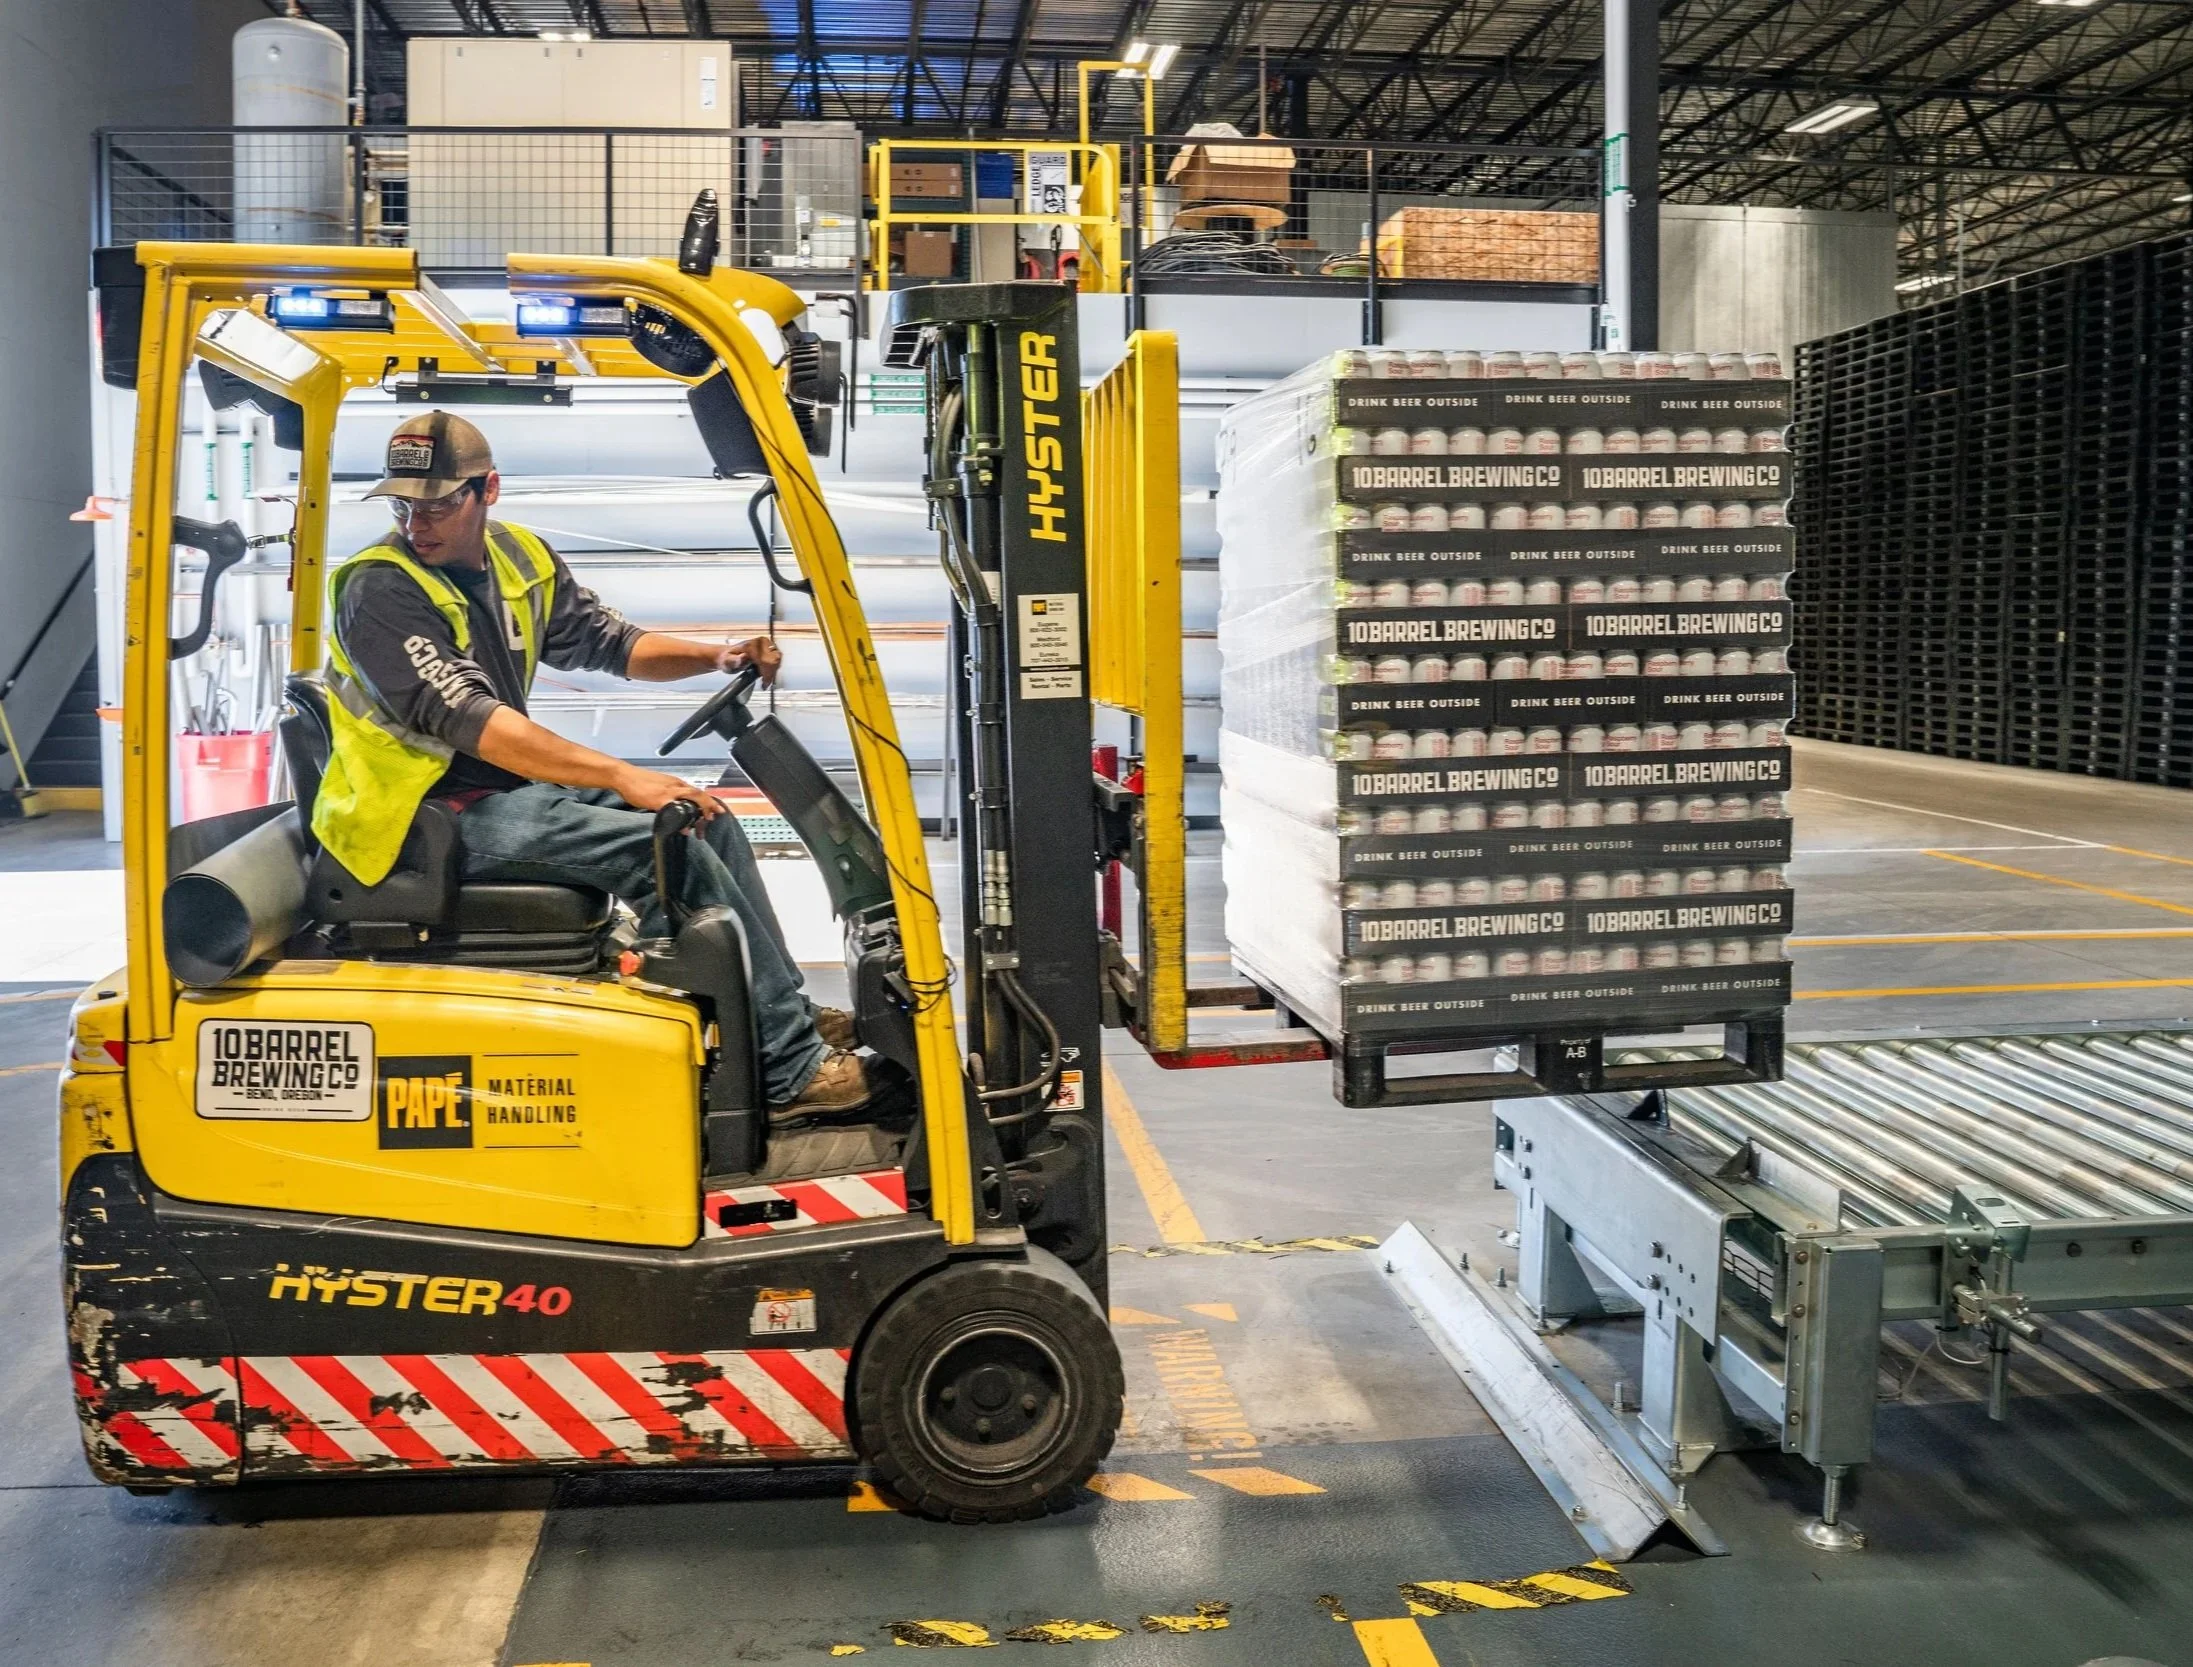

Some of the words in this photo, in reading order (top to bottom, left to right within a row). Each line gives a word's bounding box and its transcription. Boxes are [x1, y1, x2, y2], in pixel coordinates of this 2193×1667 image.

[1348, 398, 1388, 407] DRINK
[1392, 398, 1422, 407] BEER
[1426, 397, 1478, 407] OUTSIDE
[1505, 394, 1544, 404] DRINK
[1548, 394, 1577, 404] BEER
[1581, 394, 1631, 404] OUTSIDE
[1661, 400, 1698, 409] DRINK
[1702, 400, 1730, 409] BEER
[1733, 399, 1783, 409] OUTSIDE
[1019, 331, 1067, 542] HYSTER
[1510, 551, 1549, 560] DRINK
[1553, 550, 1581, 560] BEER
[1585, 550, 1636, 560] OUTSIDE
[1661, 545, 1698, 554] DRINK
[1702, 544, 1729, 554] BEER
[1733, 543, 1782, 553] OUTSIDE
[1352, 552, 1391, 562] DRINK
[1396, 552, 1426, 561] BEER
[1430, 551, 1482, 561] OUTSIDE
[1351, 700, 1391, 711] DRINK
[1395, 699, 1425, 709] BEER
[1428, 698, 1481, 708] OUTSIDE
[1510, 698, 1549, 708] DRINK
[1553, 697, 1582, 707] BEER
[1586, 695, 1636, 706] OUTSIDE
[1663, 694, 1701, 704] DRINK
[1704, 693, 1732, 703] BEER
[1736, 692, 1785, 702] OUTSIDE
[1509, 843, 1547, 854] DRINK
[1551, 842, 1580, 852] BEER
[1583, 840, 1633, 851] OUTSIDE
[1662, 842, 1699, 853] DRINK
[1703, 841, 1731, 851] BEER
[1734, 839, 1782, 850] OUTSIDE
[1353, 852, 1394, 863] DRINK
[1398, 851, 1427, 861] BEER
[1432, 848, 1483, 859] OUTSIDE
[1660, 983, 1698, 994] DRINK
[1701, 981, 1729, 991] BEER
[1732, 978, 1781, 989] OUTSIDE
[1510, 991, 1548, 1002] DRINK
[1552, 990, 1581, 1000] BEER
[1584, 987, 1634, 998] OUTSIDE
[1356, 1003, 1396, 1014] DRINK
[1400, 1002, 1429, 1012] BEER
[1433, 999, 1485, 1010] OUTSIDE
[1565, 1046, 1587, 1059] A-B
[488, 1078, 576, 1097] MATERIAL
[488, 1104, 577, 1124] HANDLING
[269, 1263, 503, 1316] HYSTER
[502, 1284, 573, 1316] 40
